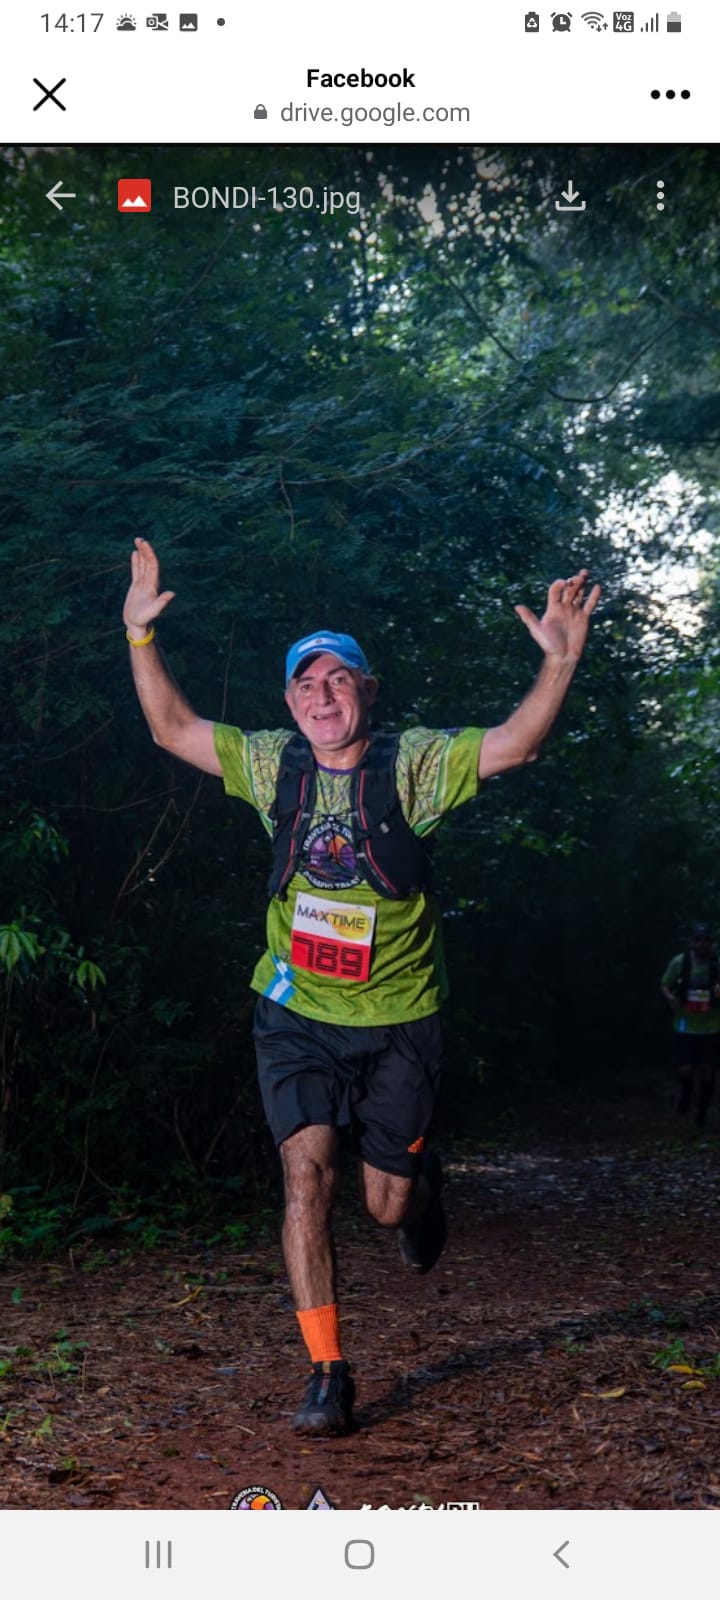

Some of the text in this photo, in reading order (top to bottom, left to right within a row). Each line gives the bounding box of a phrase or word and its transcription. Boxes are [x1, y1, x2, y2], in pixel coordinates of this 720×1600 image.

[40, 13, 104, 33] 14:17
[615, 13, 632, 21] Voz
[615, 21, 632, 31] 4G
[306, 67, 416, 88] Facebook
[280, 101, 471, 127] drive.google.com
[172, 186, 361, 214] BONDI-130.jpg
[296, 904, 366, 929] MAXTIME
[293, 935, 364, 977] 789
